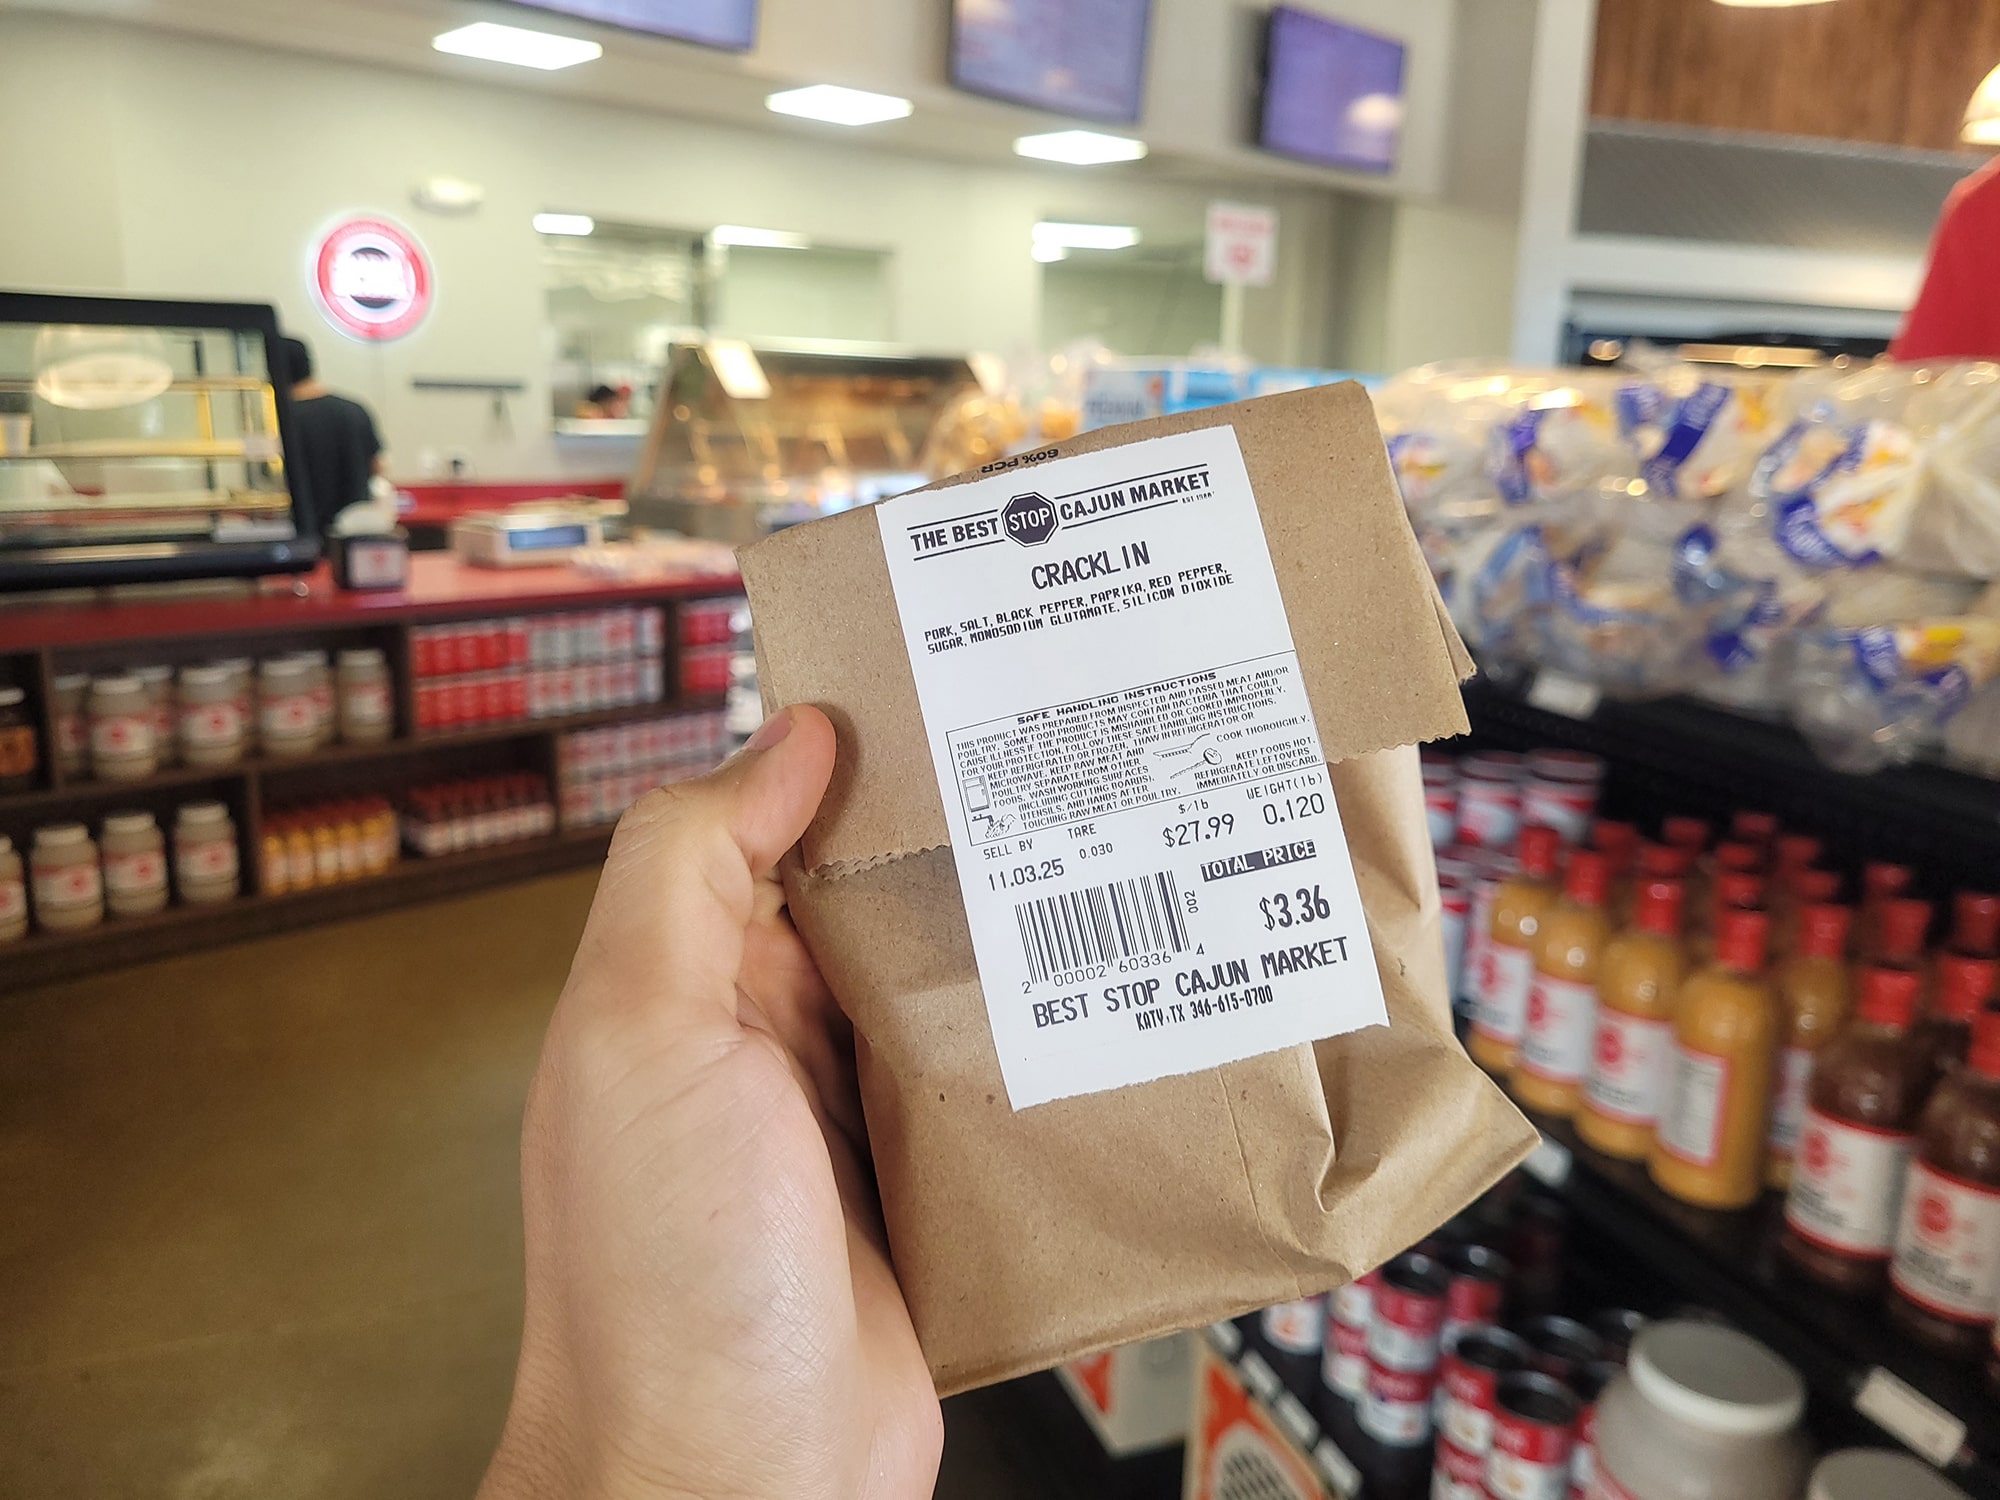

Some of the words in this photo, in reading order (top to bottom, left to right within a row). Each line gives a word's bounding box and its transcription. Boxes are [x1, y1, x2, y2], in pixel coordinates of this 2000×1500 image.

[981, 457, 1019, 474] PCR
[1022, 448, 1059, 465] 60%
[910, 529, 948, 552] THE
[952, 517, 998, 543] BEST
[1009, 508, 1049, 531] STOP
[1060, 490, 1125, 520] CAJUN
[1129, 471, 1209, 504] MARKET
[1031, 541, 1150, 590] CRACKLIN
[924, 625, 957, 642] PORK,
[960, 617, 993, 632] SALT,
[996, 607, 1033, 624] BLACK
[1040, 597, 1088, 615] PEPPER,
[1090, 582, 1146, 604] PAPRIKA,
[1149, 575, 1171, 589] RED
[1178, 563, 1227, 582] PEPPER,
[928, 636, 967, 654] SUGAR,
[970, 618, 1043, 643] MONOSODIUM
[1123, 587, 1175, 609] SILICON
[1181, 574, 1234, 594] DIOXIDE
[957, 740, 975, 751] THIS
[977, 730, 1016, 746] PRODUCT
[1019, 724, 1040, 735] WAS
[1042, 714, 1088, 730] PREPARED
[1090, 707, 1116, 719] FROM
[1118, 695, 1166, 713] INSPECTED
[1169, 690, 1186, 700] AND
[1189, 681, 1224, 696] PASSED
[1226, 675, 1251, 687] MEAT
[1256, 666, 1288, 680] AND/OR
[1017, 711, 1050, 725] SAFE
[1056, 696, 1119, 716] HANDLING
[1124, 672, 1216, 700] INSTRUCTIONS
[958, 744, 1000, 760] POULTRY.
[1004, 736, 1029, 748] SOME
[1031, 730, 1055, 742] FOOD
[1057, 719, 1105, 736] PRODUCTS
[1107, 713, 1127, 724] MAY
[1131, 703, 1170, 719] CONTAIN
[1221, 686, 1243, 697] THAT
[1247, 677, 1278, 691] COULD
[960, 756, 986, 768] CAUSE
[990, 746, 1025, 761] ILLNESS
[1027, 744, 1034, 753] IF
[1038, 740, 1053, 749] THE
[1056, 730, 1097, 745] PRODUCT
[1100, 727, 1109, 736] IS
[1111, 713, 1168, 733] MISHANDLED
[1171, 709, 1184, 718] OR
[1186, 700, 1222, 715] COOKED
[1225, 686, 1285, 706] IMPROPERLY.
[1216, 730, 1243, 742] COOK
[1245, 715, 1309, 735] THOROUGHLY.
[962, 767, 979, 778] FOR
[980, 761, 1004, 773] YOUR
[1065, 737, 1103, 753] FOLLOW
[1107, 731, 1131, 743] THESE
[1136, 725, 1156, 736] SAFE
[1160, 714, 1205, 731] HANDLING
[988, 769, 1008, 780] KEEP
[1077, 751, 1090, 760] OR
[1134, 734, 1159, 746] THAW
[1241, 712, 1254, 721] OR
[1194, 760, 1254, 780] REFRIGERATE
[1257, 747, 1310, 765] LEFTOVERS
[1236, 749, 1257, 761] KEEP
[1260, 741, 1291, 755] FOODS
[1293, 737, 1315, 747] HOT.
[990, 770, 1047, 790] MICROWAVE.
[1050, 764, 1070, 776] KEEP
[1074, 758, 1094, 770] RAW
[1097, 752, 1122, 764] MEAT
[1127, 747, 1144, 758] AND
[992, 783, 1031, 799] POULTRY
[1034, 772, 1080, 789] SEPARATE
[1082, 765, 1108, 778] FROM
[1111, 758, 1140, 771] OTHER
[1029, 786, 1056, 799] WASH
[1057, 777, 1099, 792] WORKING
[1102, 766, 1148, 782] SURFACES
[1197, 768, 1258, 790] IMMEDIATELY
[1262, 765, 1275, 774] OR
[1023, 813, 1067, 830] TOUCHING
[1069, 807, 1090, 819] RAW
[1092, 801, 1117, 813] MEAT
[1121, 798, 1134, 807] OR
[1136, 787, 1180, 804] POULTRY.
[1067, 799, 1085, 810] AND
[1087, 792, 1117, 805] HANDS
[1120, 785, 1149, 798] AFTER
[1070, 784, 1109, 799] CUTTING
[1263, 793, 1324, 825] 0.120
[1067, 823, 1096, 839] TARE
[1163, 813, 1234, 848] $27.99
[983, 844, 1012, 860] SELL
[1019, 838, 1032, 851] BY
[1079, 843, 1113, 859] 0.030
[1202, 856, 1255, 879] TOTAL
[1262, 841, 1317, 866] PRICE
[989, 858, 1064, 891] 11.03.25
[1184, 890, 1199, 913] 002
[1259, 885, 1330, 931] $3.36
[1022, 981, 1032, 994] 2
[1054, 965, 1107, 987] 00002
[1119, 951, 1171, 973] 60336
[1196, 943, 1204, 955] 4
[1032, 993, 1088, 1028] BEST
[1103, 978, 1160, 1012] STOP
[1175, 959, 1250, 997] CAJUN
[1260, 936, 1347, 979] MARKET
[1190, 984, 1273, 1019] 346-615-0700
